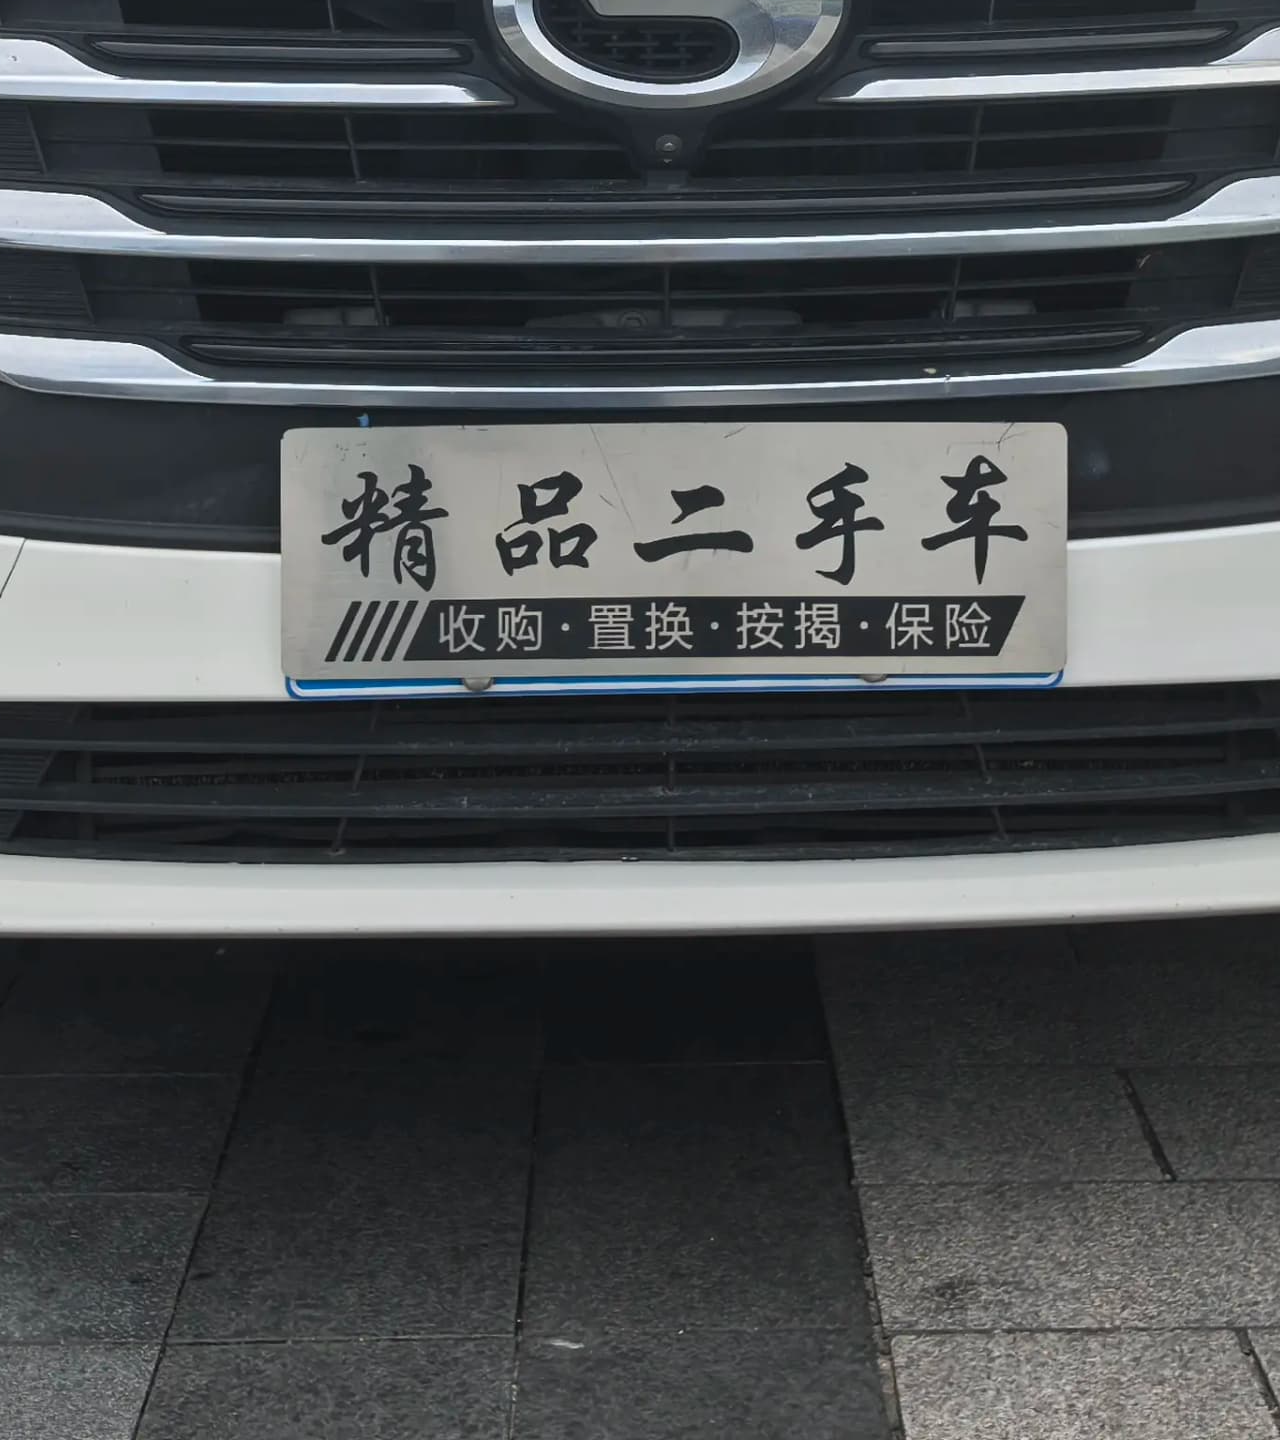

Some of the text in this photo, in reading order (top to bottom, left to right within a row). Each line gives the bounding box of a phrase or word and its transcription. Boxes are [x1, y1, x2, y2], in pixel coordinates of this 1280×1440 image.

[321, 455, 1029, 593] 精品二手车
[437, 600, 994, 653] 收购·置换·按揭·保险
